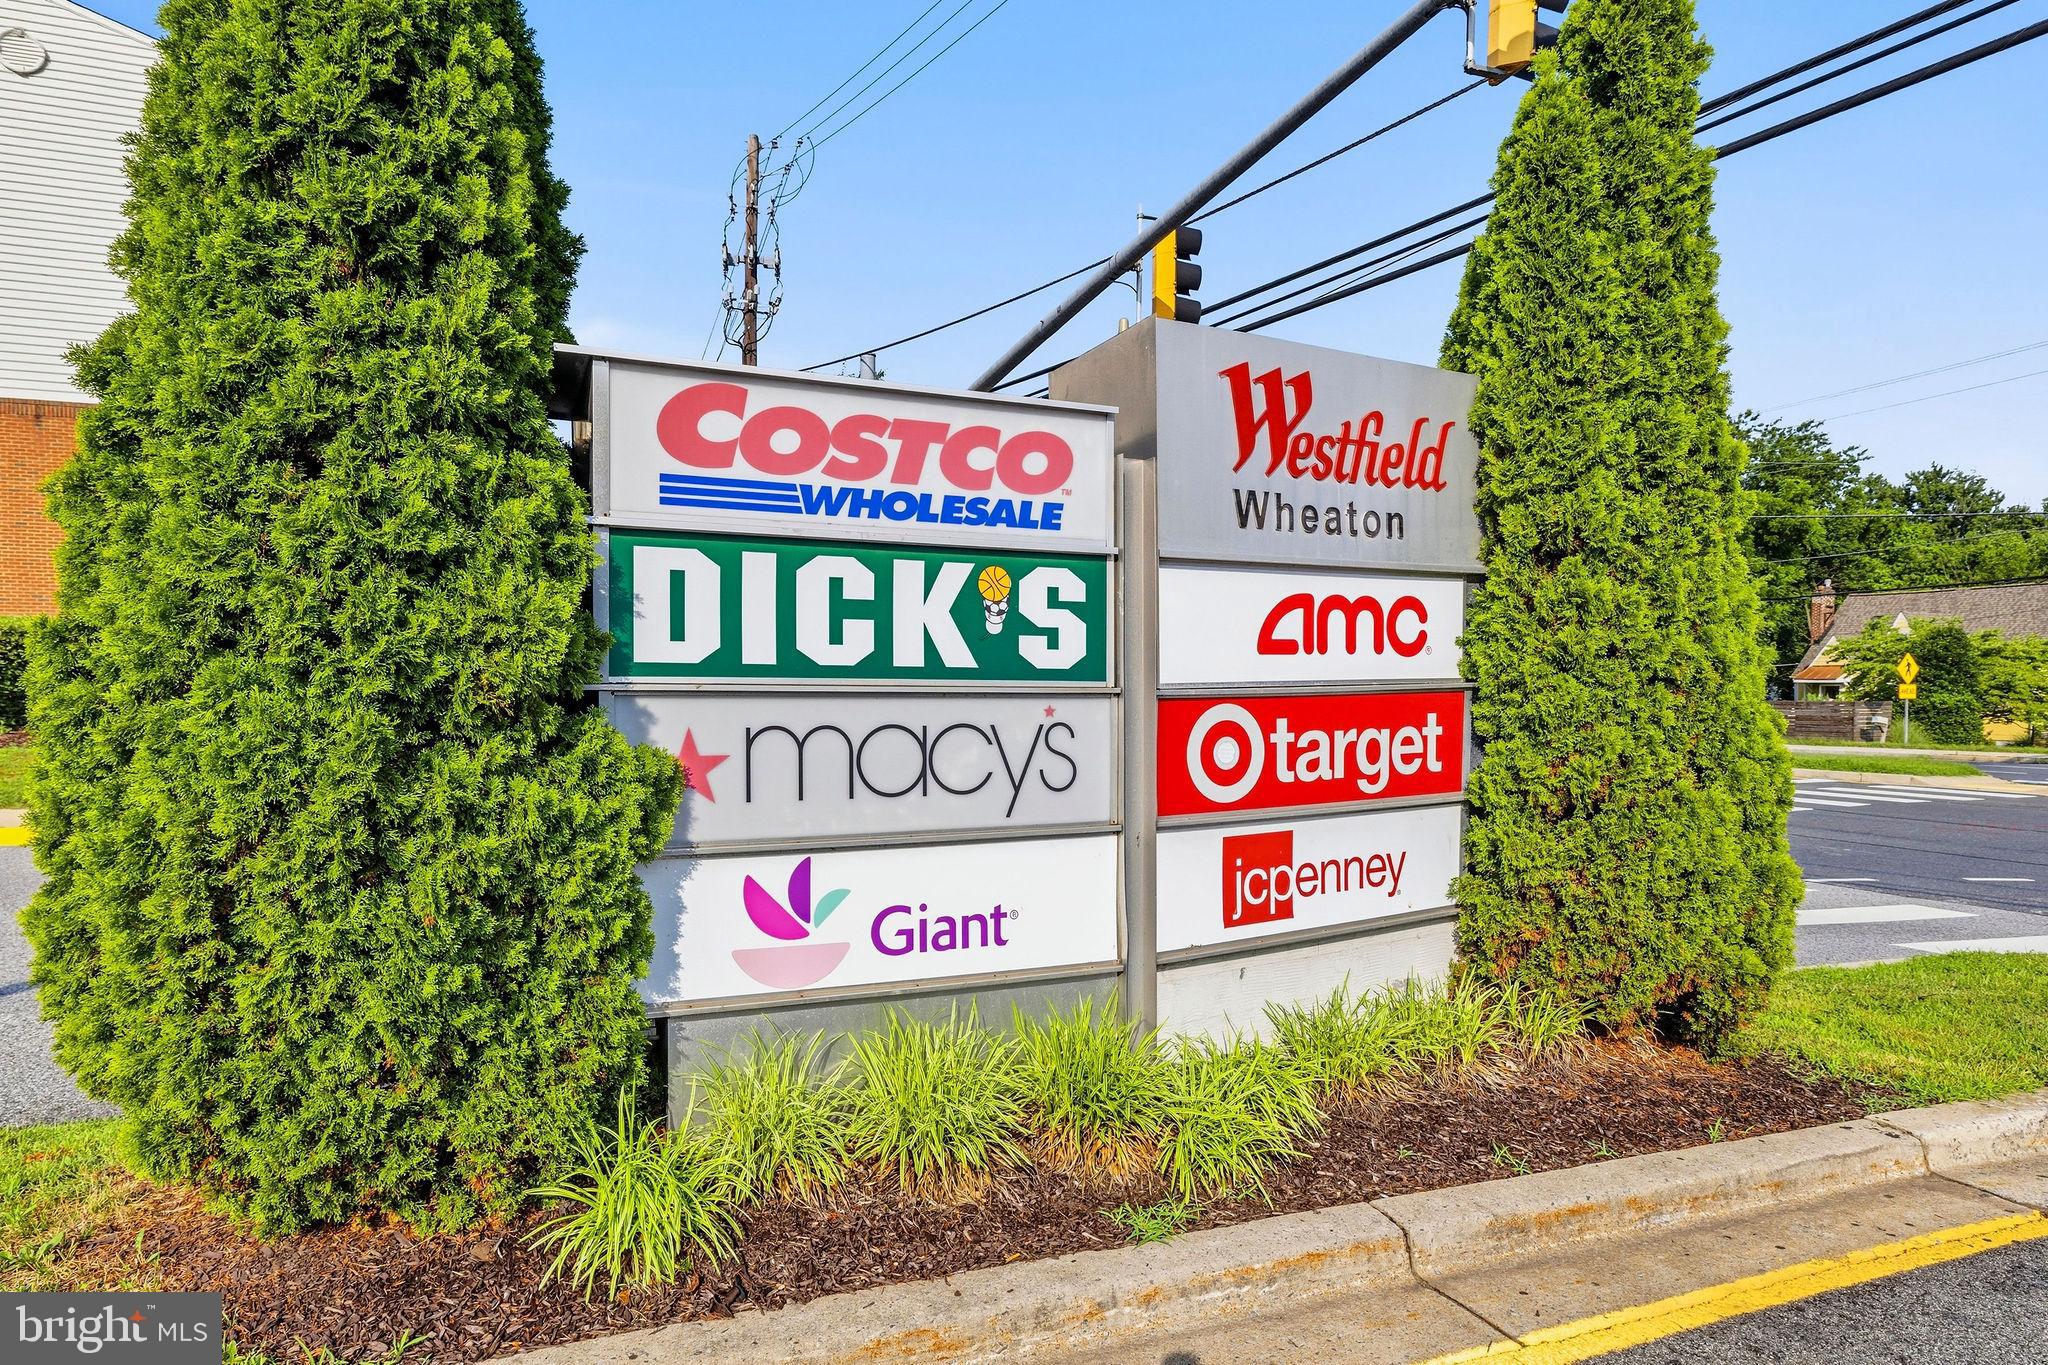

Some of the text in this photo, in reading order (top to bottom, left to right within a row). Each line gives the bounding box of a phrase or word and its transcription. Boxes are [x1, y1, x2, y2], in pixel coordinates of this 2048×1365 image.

[656, 382, 1074, 496] COSTCO
[1218, 361, 1456, 493] Westfield
[799, 484, 1064, 531] WHOLESALE
[1232, 488, 1405, 540] Wheaton
[633, 545, 1087, 669] DICK'S
[745, 704, 1078, 818] macy's
[1269, 712, 1443, 795] target
[1232, 851, 1406, 920] jcpenney
[870, 903, 1010, 956] Giant
